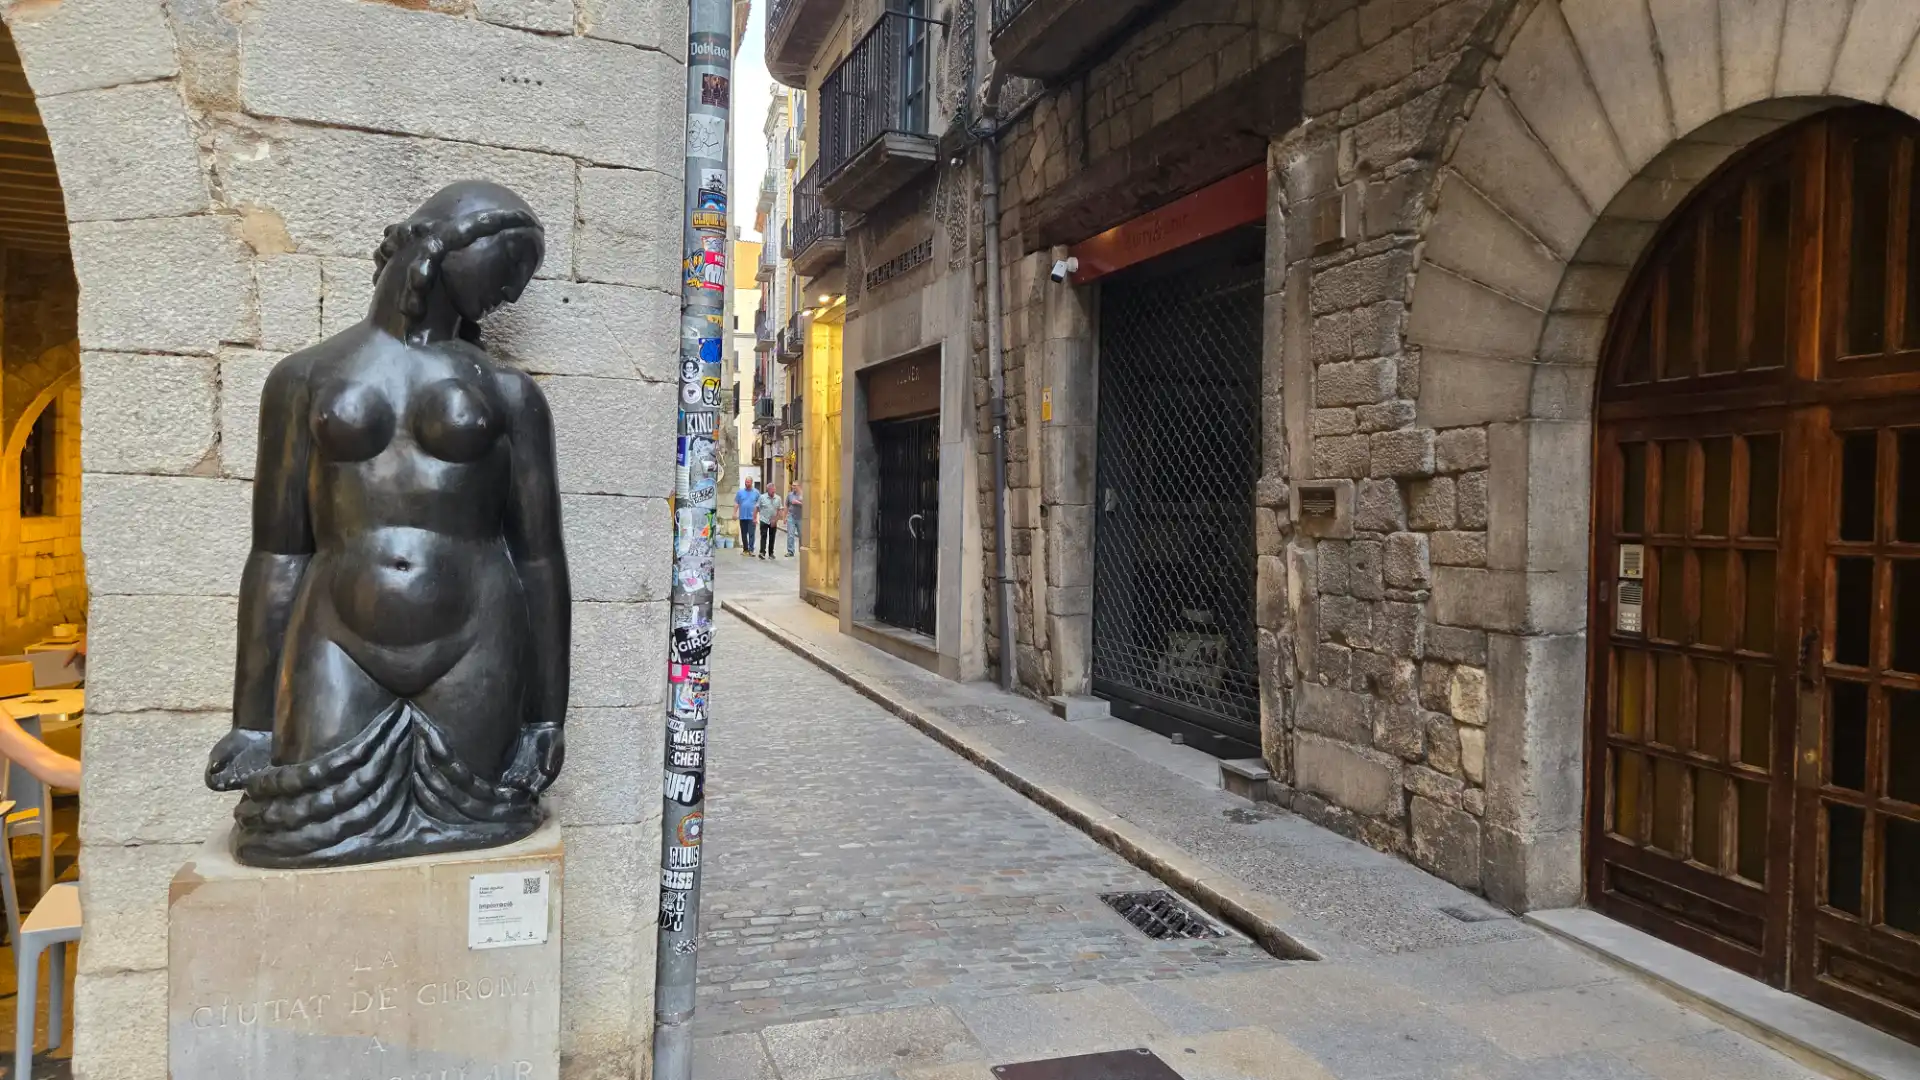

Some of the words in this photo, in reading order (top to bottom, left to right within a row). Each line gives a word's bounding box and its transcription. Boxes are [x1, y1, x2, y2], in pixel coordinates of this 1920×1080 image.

[686, 413, 713, 433] KINO
[673, 751, 700, 766] CHER
[671, 847, 699, 867] GALLUS
[673, 892, 687, 932] KUTU
[353, 950, 399, 972] LA
[192, 994, 331, 1030] CIUTAT
[350, 987, 398, 1014] DE
[416, 976, 538, 1006] GIRONA
[364, 1035, 387, 1054] A
